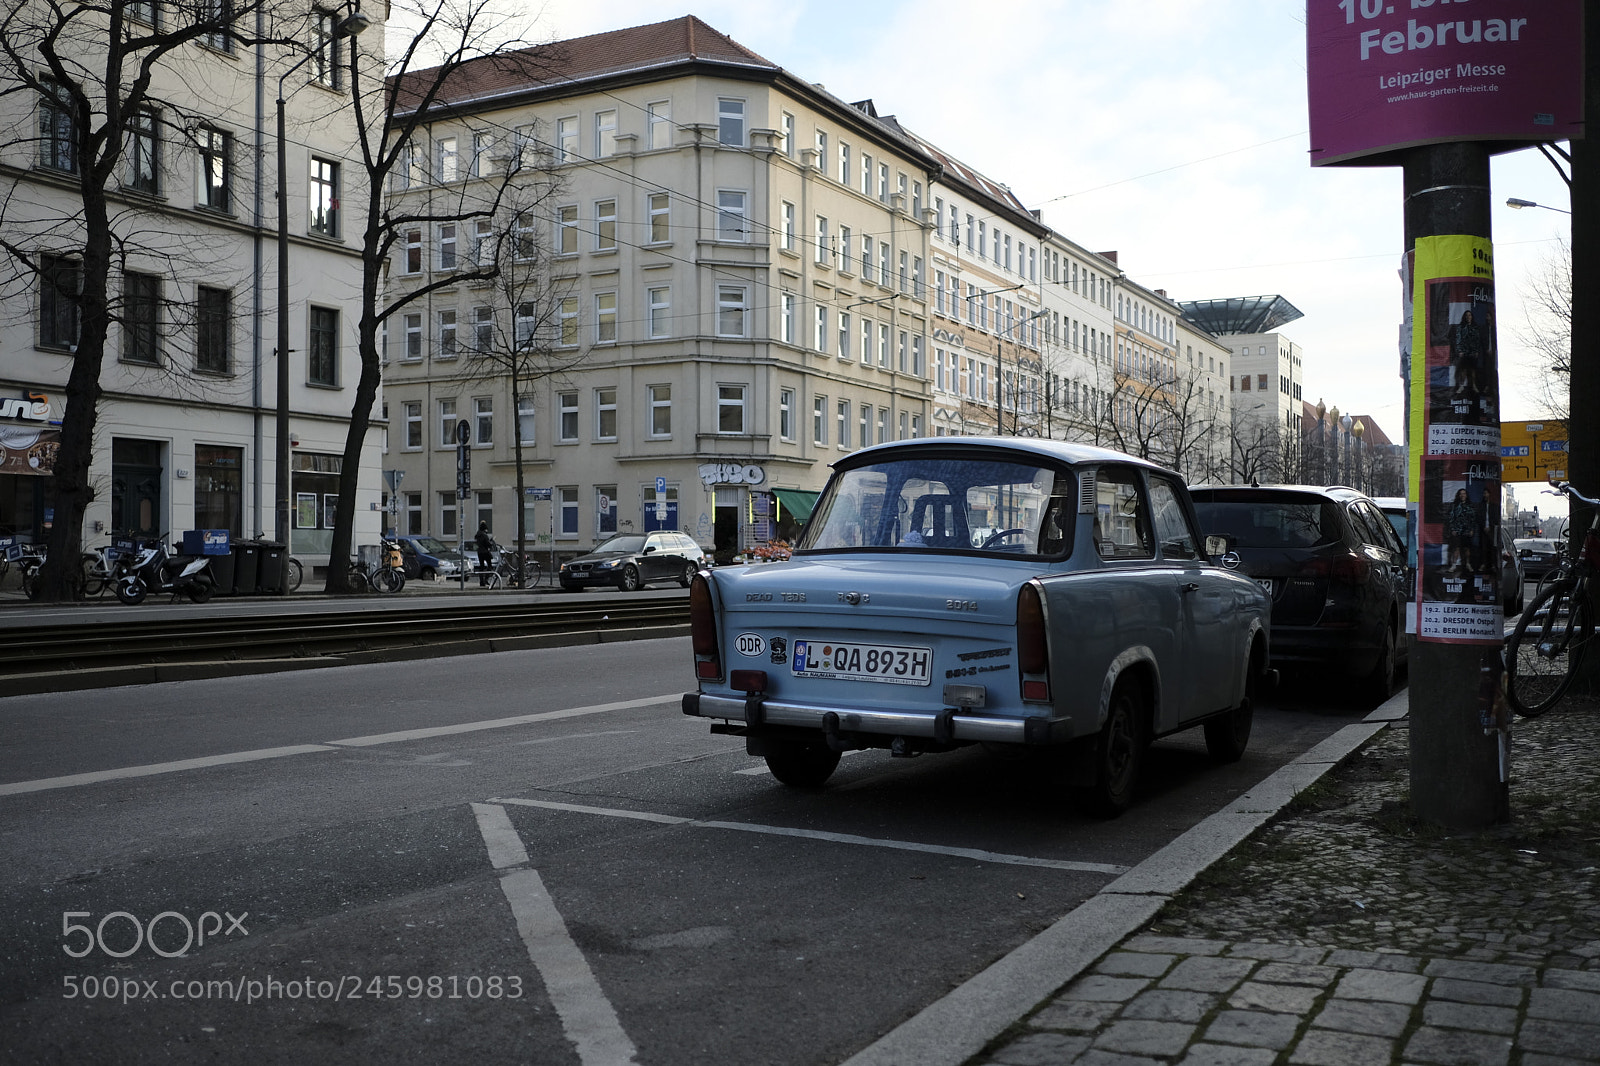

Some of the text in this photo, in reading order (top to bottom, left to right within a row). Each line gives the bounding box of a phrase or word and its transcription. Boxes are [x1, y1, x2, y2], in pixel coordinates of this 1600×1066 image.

[1338, 0, 1394, 24] 10.
[1360, 18, 1527, 61] Februar
[1380, 62, 1506, 90] Leipziger Messe
[1387, 83, 1499, 104] www.haus-garten-freizeit.de
[1450, 438, 1480, 446] DRESDEN
[746, 592, 773, 603] DEAD
[946, 599, 978, 611] 2014
[1443, 617, 1475, 625] DRESDEN
[1477, 618, 1495, 626] Ostpol
[1443, 627, 1467, 635] BERLIN
[1470, 628, 1496, 636] Monarch
[740, 637, 761, 653] DDR
[806, 645, 819, 668] L
[834, 647, 861, 672] QA
[865, 649, 927, 677] 893H
